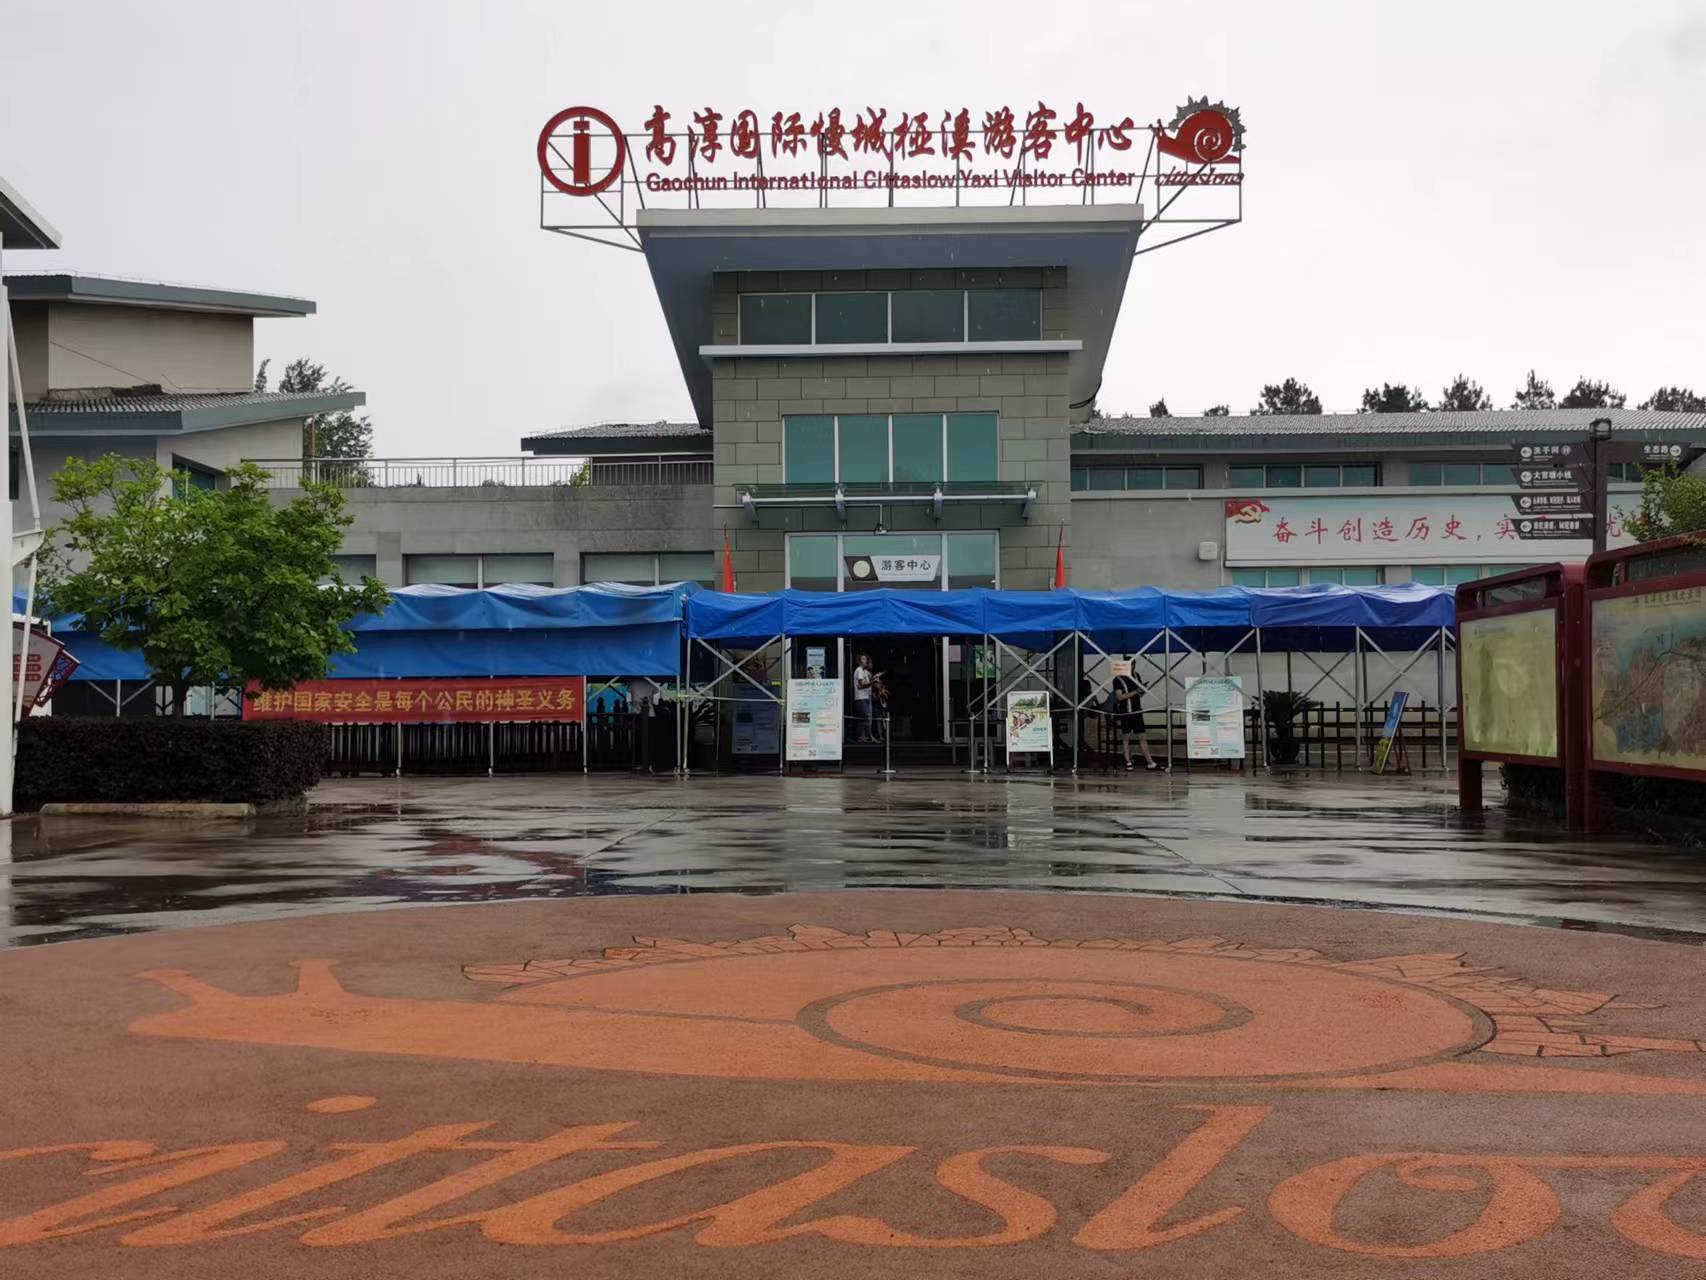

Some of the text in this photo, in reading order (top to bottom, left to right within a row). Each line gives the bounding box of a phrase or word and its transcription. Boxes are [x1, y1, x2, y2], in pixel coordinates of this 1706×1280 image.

[646, 168, 1135, 192] Gaochun International Cittaslow Yaxi Visitor Center
[881, 559, 931, 571] 游客中心
[253, 687, 576, 713] 维护国家安全是每个公民的神圣义务
[0, 1093, 1706, 1262] ittaslo
